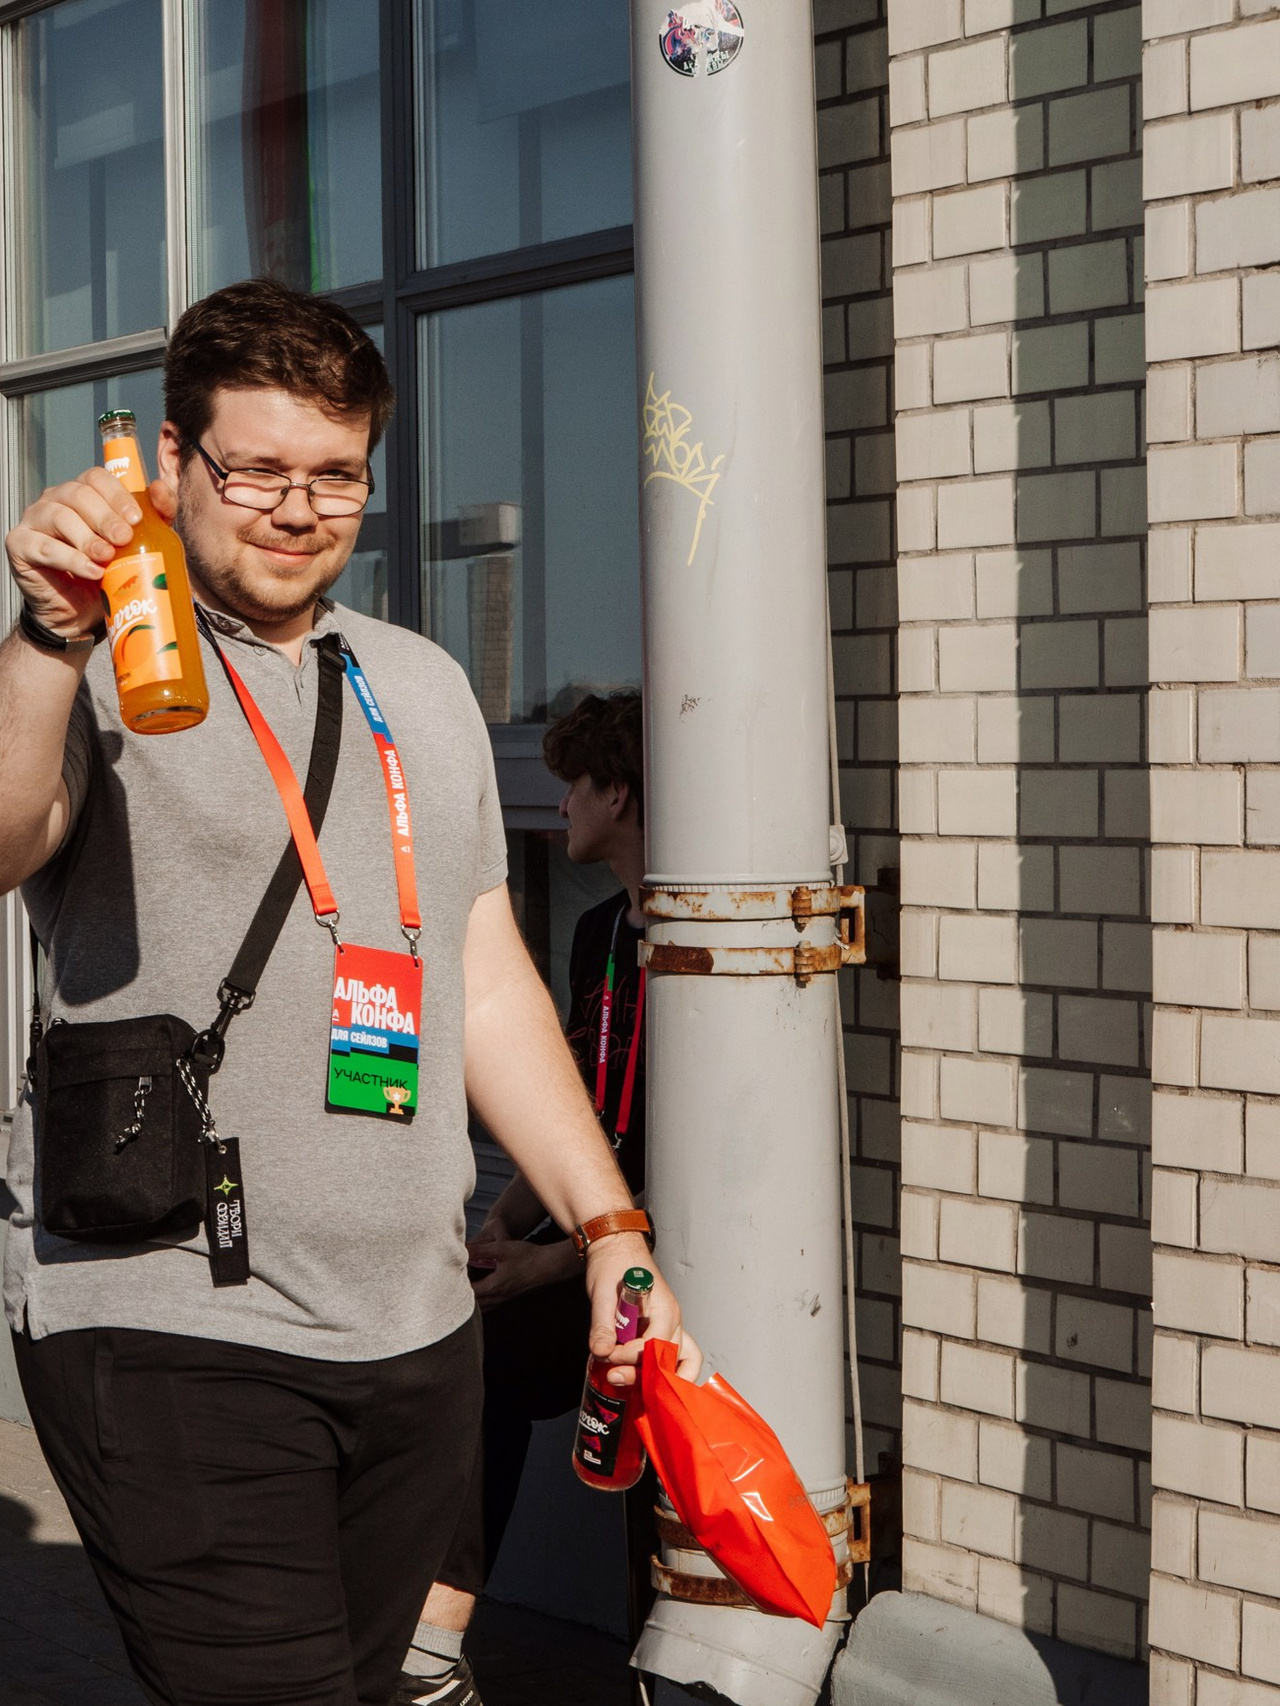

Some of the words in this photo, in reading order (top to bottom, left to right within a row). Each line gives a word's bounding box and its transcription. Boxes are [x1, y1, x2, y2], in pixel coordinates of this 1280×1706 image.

[386, 749, 404, 790] КОНФА
[394, 792, 410, 837] АЛЬФА
[334, 977, 398, 1009] АЛЬФА
[351, 1002, 415, 1035] КОНФА
[601, 1005, 609, 1034] АЛЬФА
[331, 1028, 349, 1042] ДЛЯ
[350, 1030, 388, 1048] СЕЙЛЗОВ
[599, 1035, 607, 1064] КОНФА
[334, 1067, 408, 1091] УЧАСТНИК
